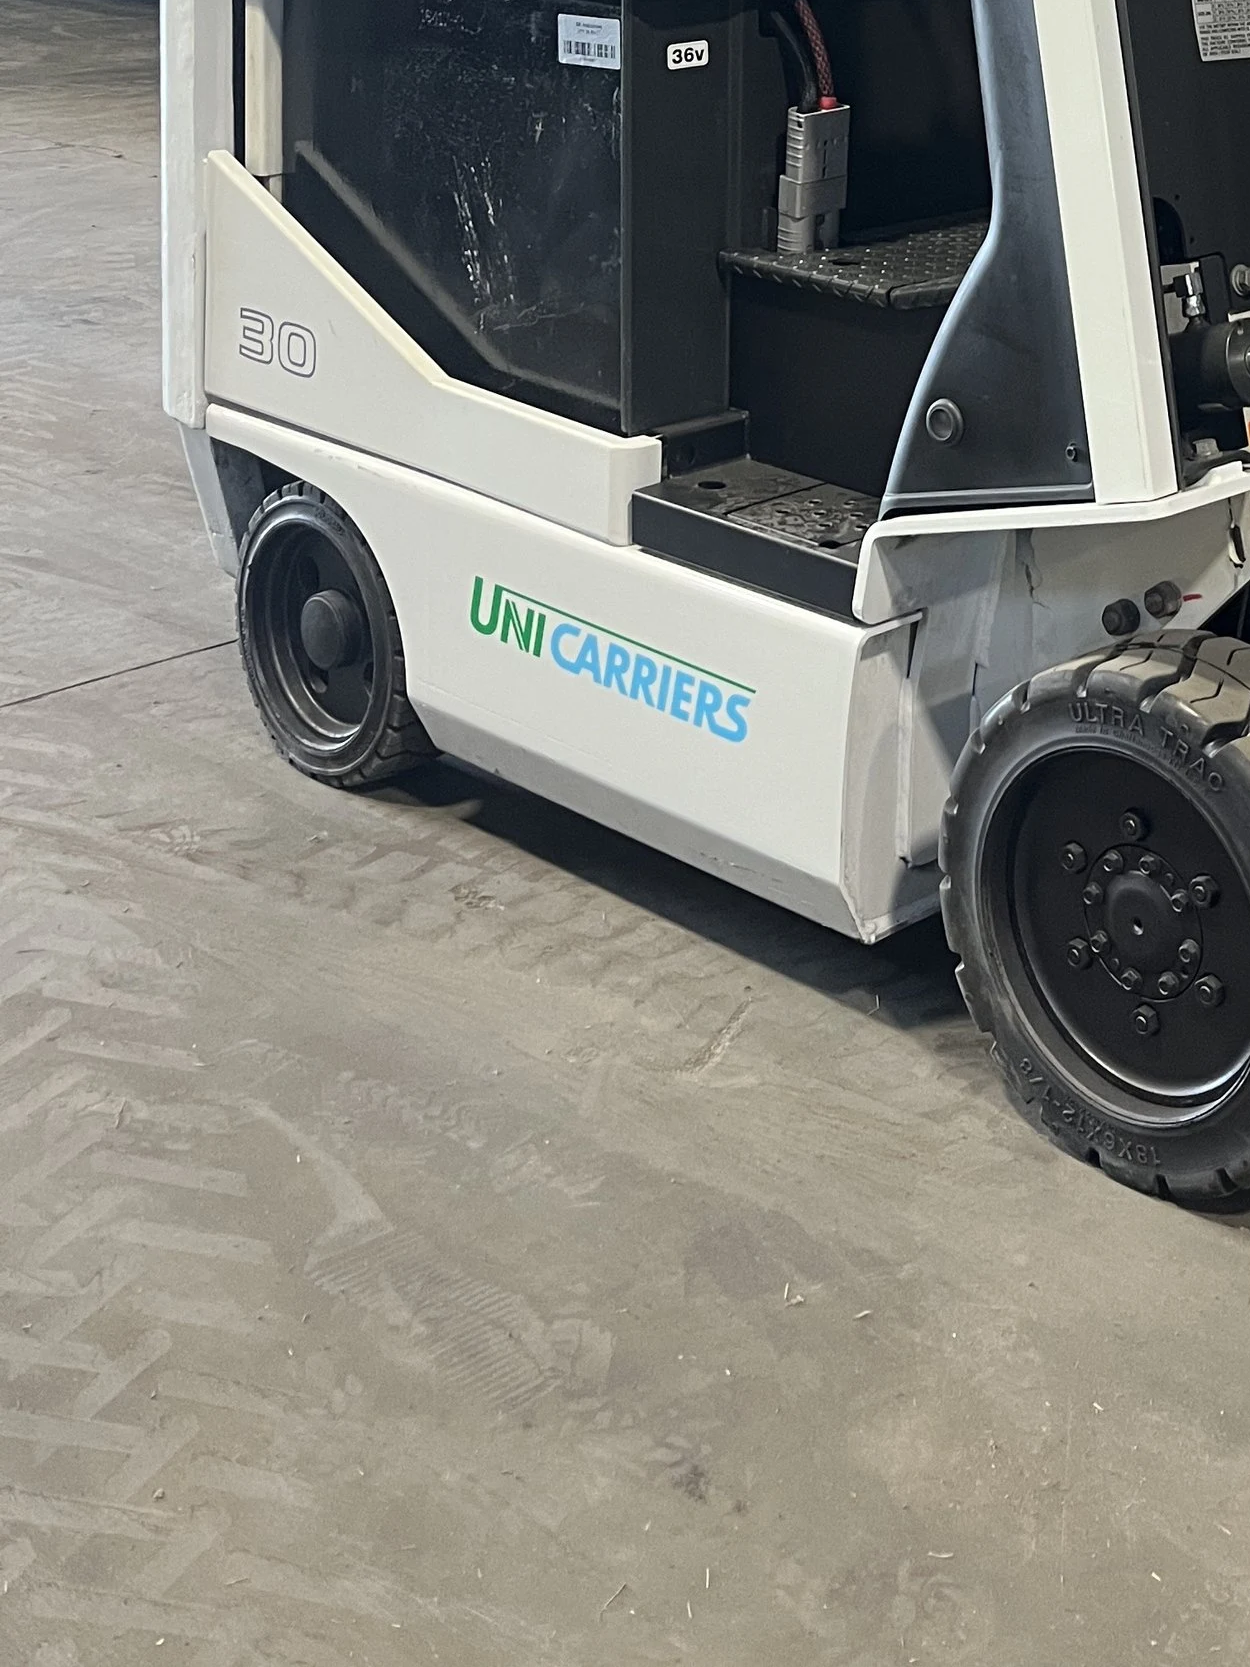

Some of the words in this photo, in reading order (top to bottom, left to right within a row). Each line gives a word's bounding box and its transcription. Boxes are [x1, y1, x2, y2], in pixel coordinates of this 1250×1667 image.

[671, 47, 705, 65] 36v
[239, 306, 317, 378] 30
[1068, 701, 1145, 737] ULTRA
